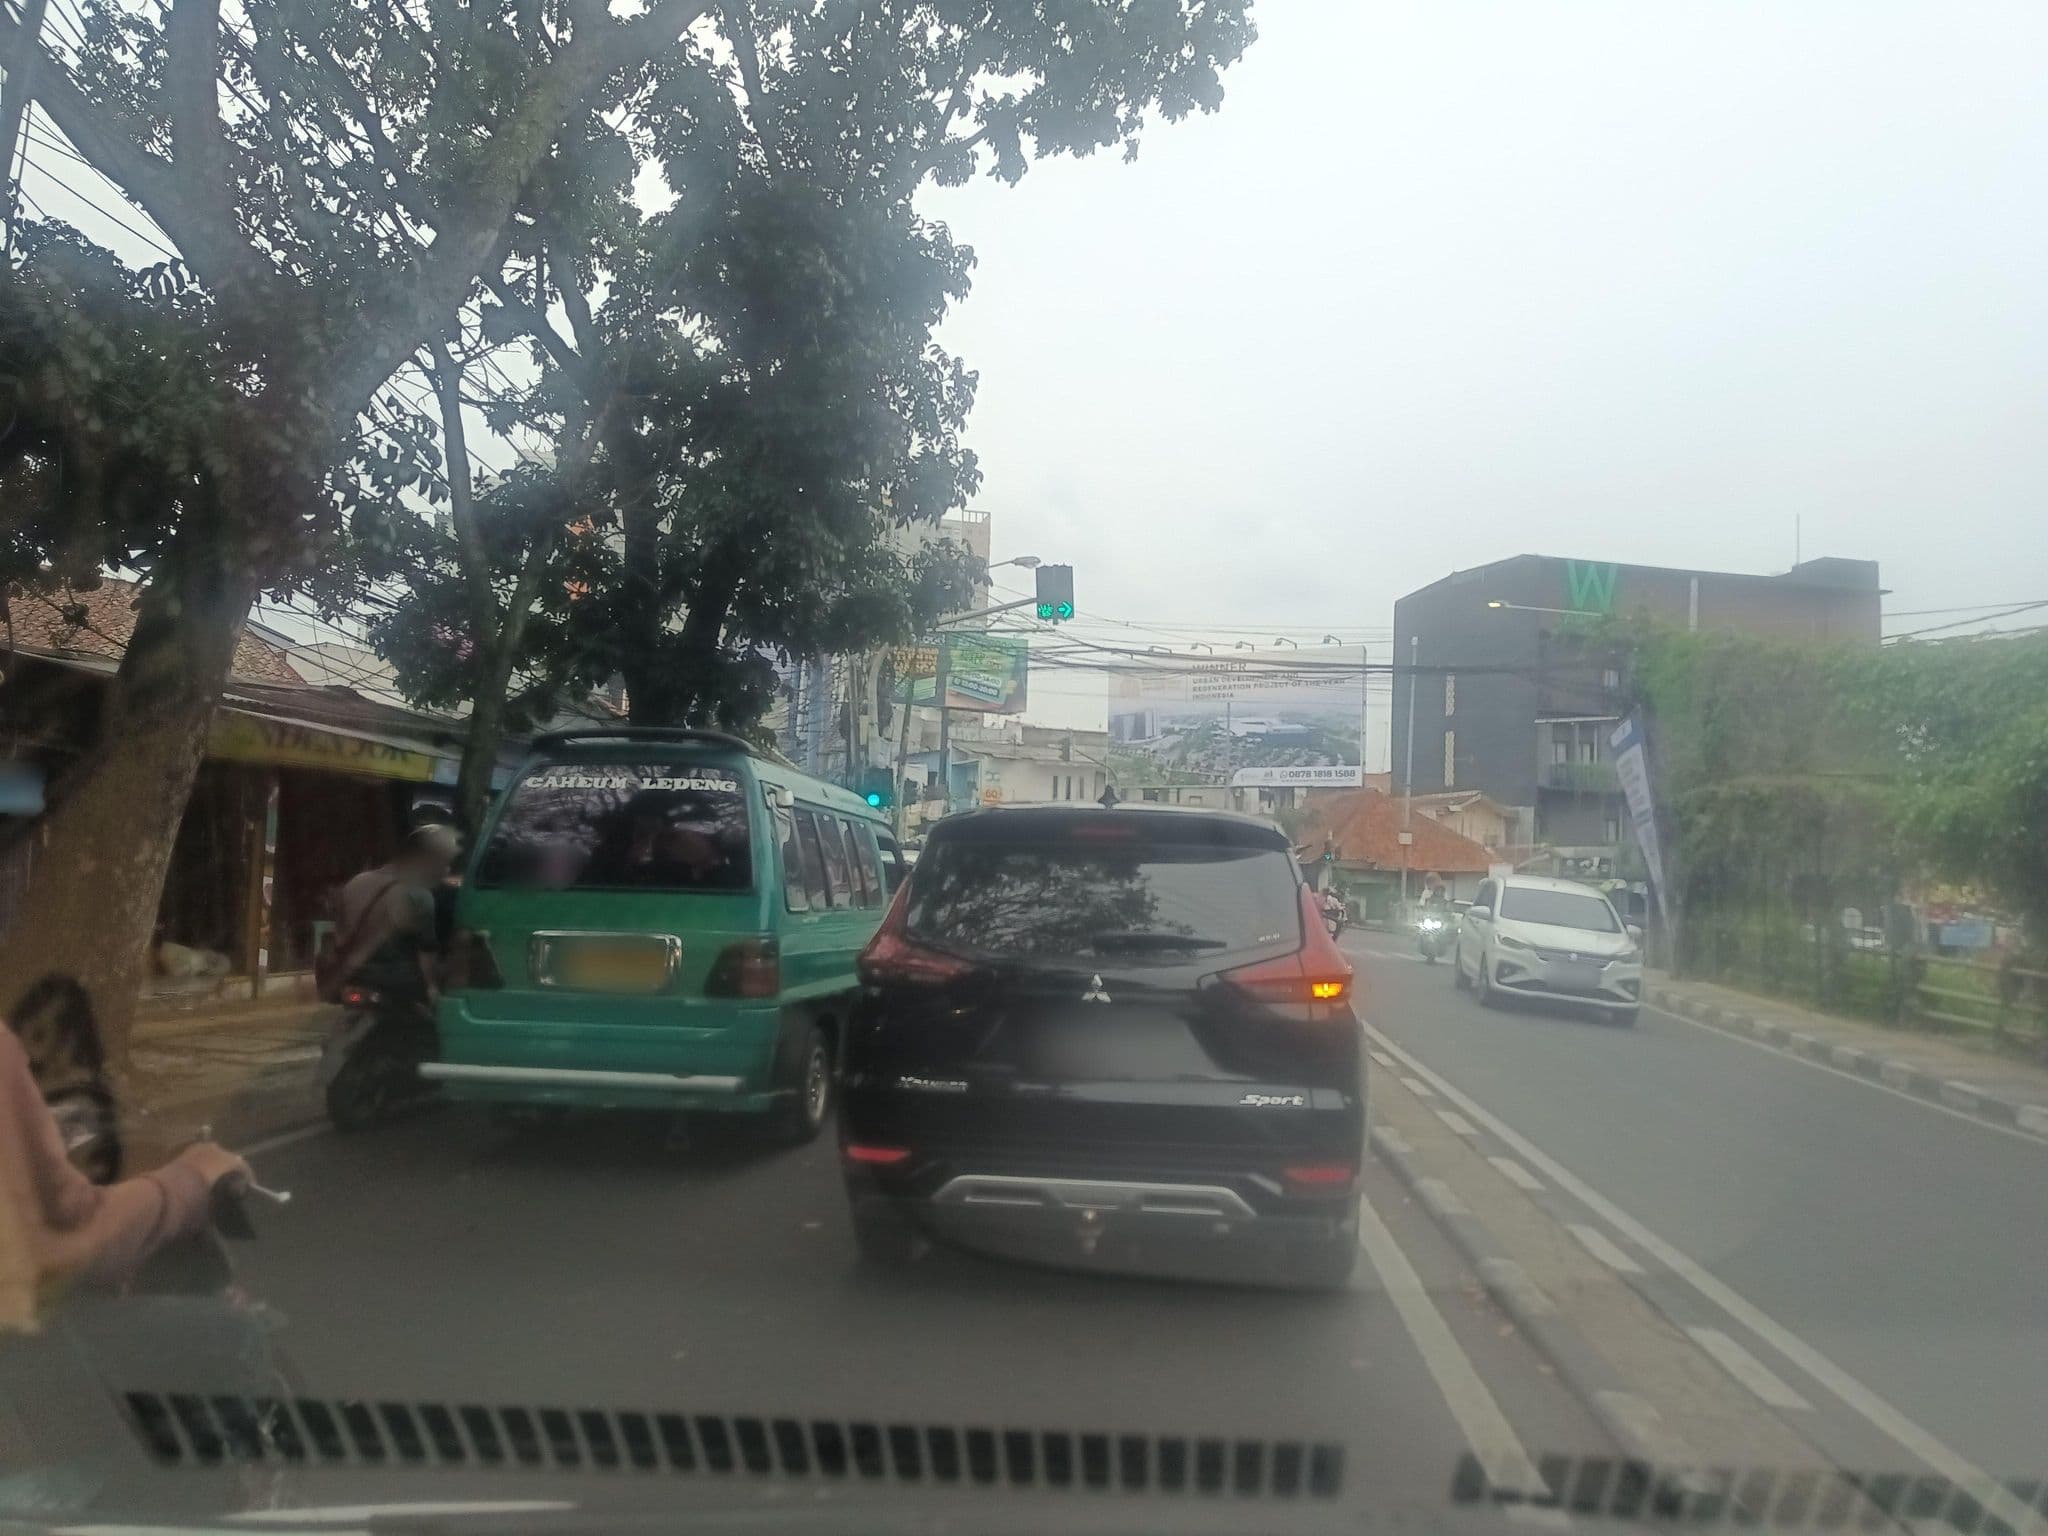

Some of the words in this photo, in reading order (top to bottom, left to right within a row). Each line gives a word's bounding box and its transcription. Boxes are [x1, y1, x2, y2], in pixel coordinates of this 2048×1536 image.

[1566, 560, 1618, 609] W
[1192, 662, 1247, 672] WINNER
[1288, 770, 1312, 778] 0878
[1313, 770, 1332, 778] 1818
[1335, 769, 1356, 778] 1588
[526, 776, 629, 789] CAHEUM
[640, 777, 738, 792] LEDENG
[1239, 1094, 1304, 1107] Sport
